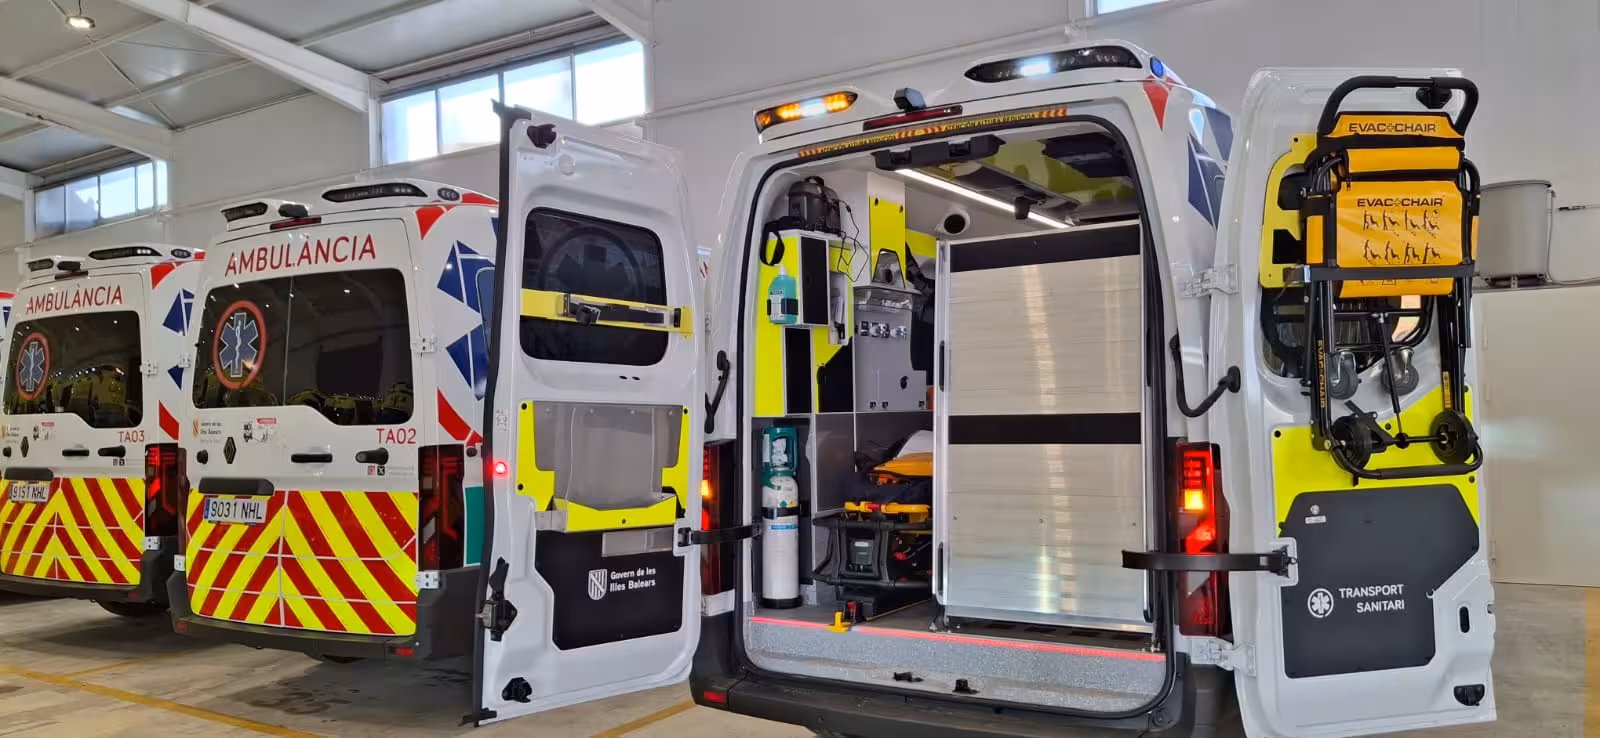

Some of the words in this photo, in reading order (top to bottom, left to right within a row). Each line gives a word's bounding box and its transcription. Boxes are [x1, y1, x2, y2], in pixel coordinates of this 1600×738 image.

[225, 233, 376, 277] AMBULÀNCIA
[26, 283, 123, 315] AMBULÀNCIA
[118, 430, 145, 443] TA03
[376, 428, 417, 444] TA02
[32, 487, 46, 500] NHL
[241, 502, 262, 520] NHL
[610, 570, 635, 580] Govern
[636, 567, 645, 577] de
[646, 567, 656, 576] les
[610, 582, 626, 592] Illes
[628, 579, 656, 589] Balears
[1338, 584, 1404, 599] TRANSPORT
[1356, 599, 1405, 613] SANITARI
